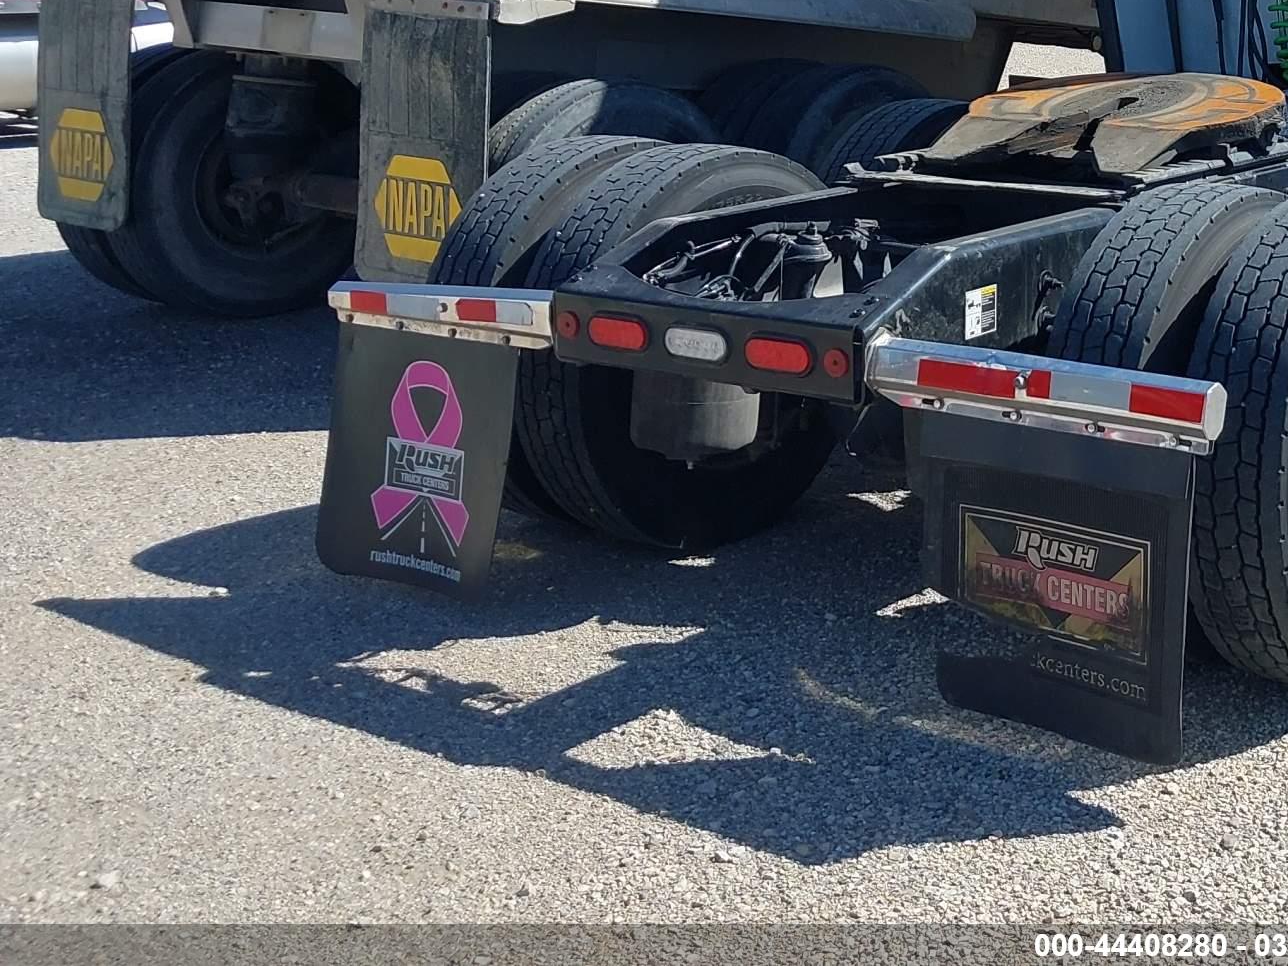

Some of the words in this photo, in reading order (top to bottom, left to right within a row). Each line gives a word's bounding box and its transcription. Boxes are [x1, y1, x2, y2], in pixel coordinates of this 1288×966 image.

[61, 129, 103, 178] NAPA
[387, 178, 447, 239] NAPA
[395, 443, 456, 474] RUSH
[400, 471, 422, 485] TRUCK
[422, 475, 450, 491] CENTERS
[369, 549, 462, 583] rushtruckcenters.com
[1012, 525, 1099, 572] RUSH
[978, 560, 1042, 591] TRUCK
[1046, 575, 1131, 618] CENTERS
